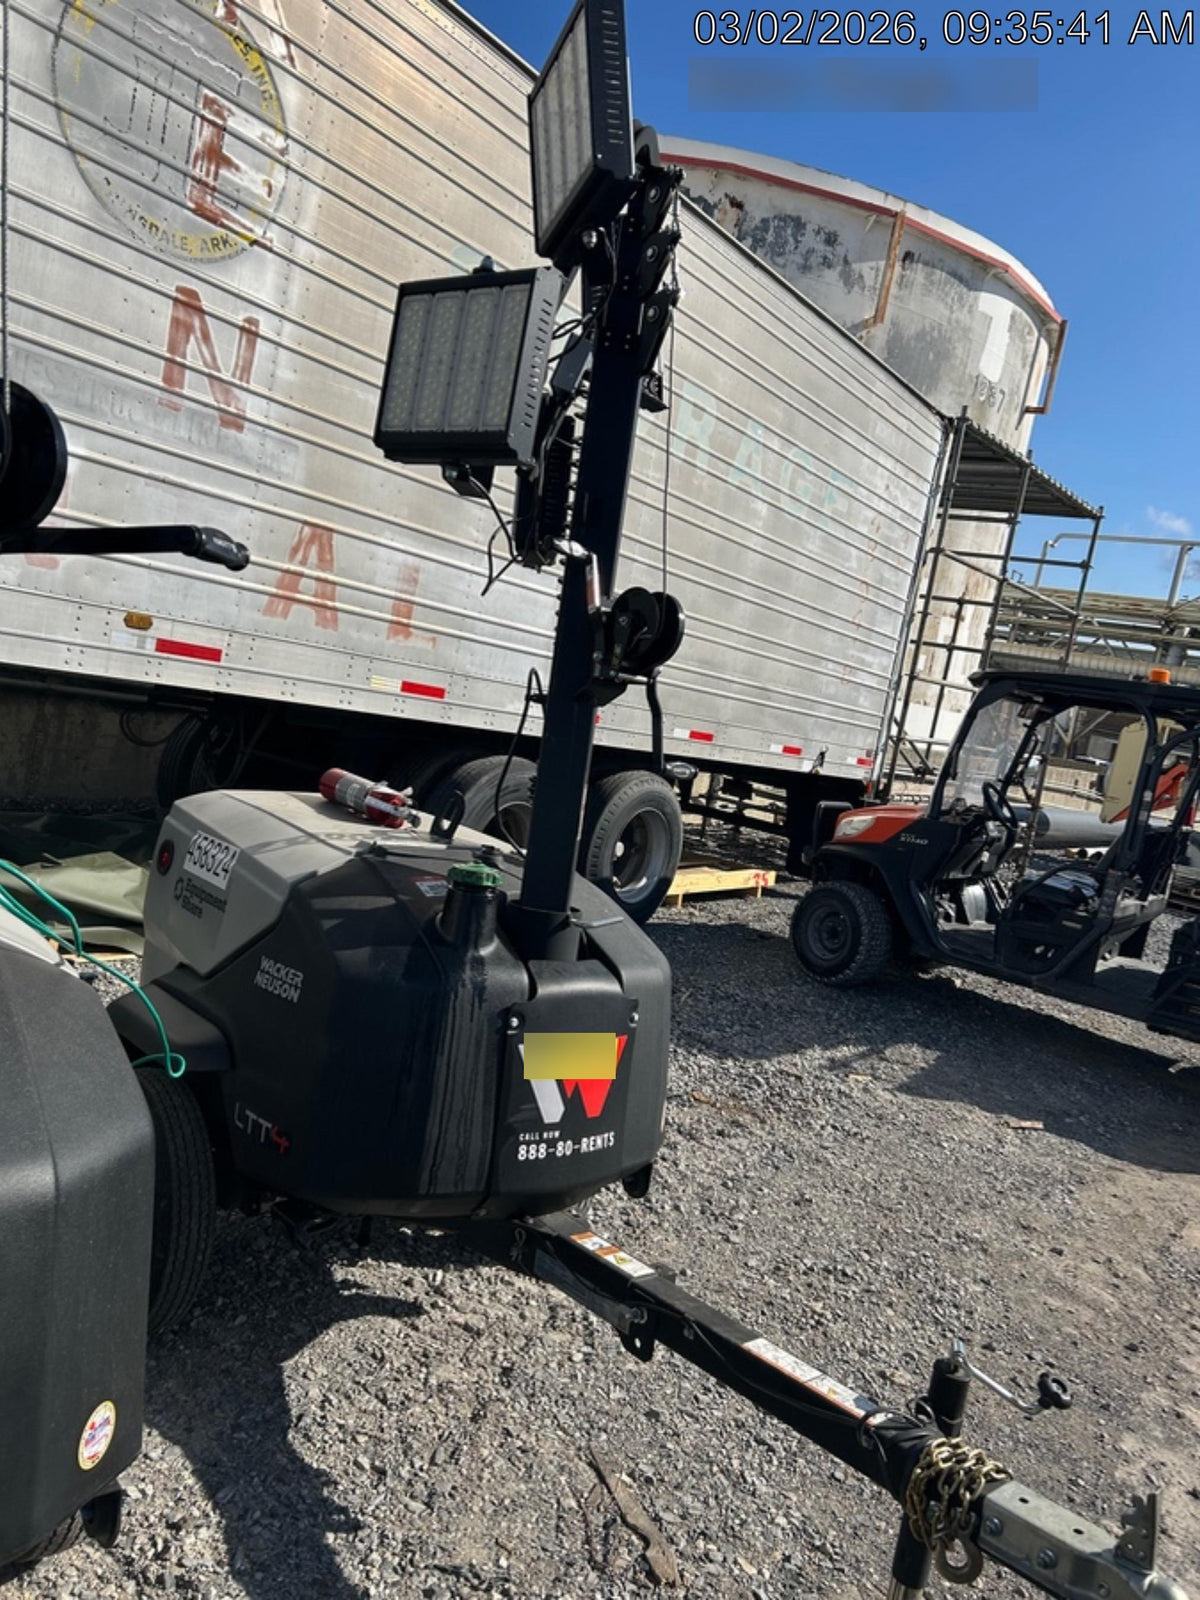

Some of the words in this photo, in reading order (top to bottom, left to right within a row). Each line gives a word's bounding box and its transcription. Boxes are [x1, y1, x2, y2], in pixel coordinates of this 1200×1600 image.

[200, 232, 239, 253] ARK.
[186, 832, 238, 881] 458324
[253, 970, 302, 1003] NEUSON
[260, 955, 304, 987] WACKER
[233, 1101, 290, 1154] LTT4
[518, 1132, 541, 1141] CALL
[543, 1130, 561, 1140] NOW
[517, 1131, 616, 1161] 888-80-RENTS
